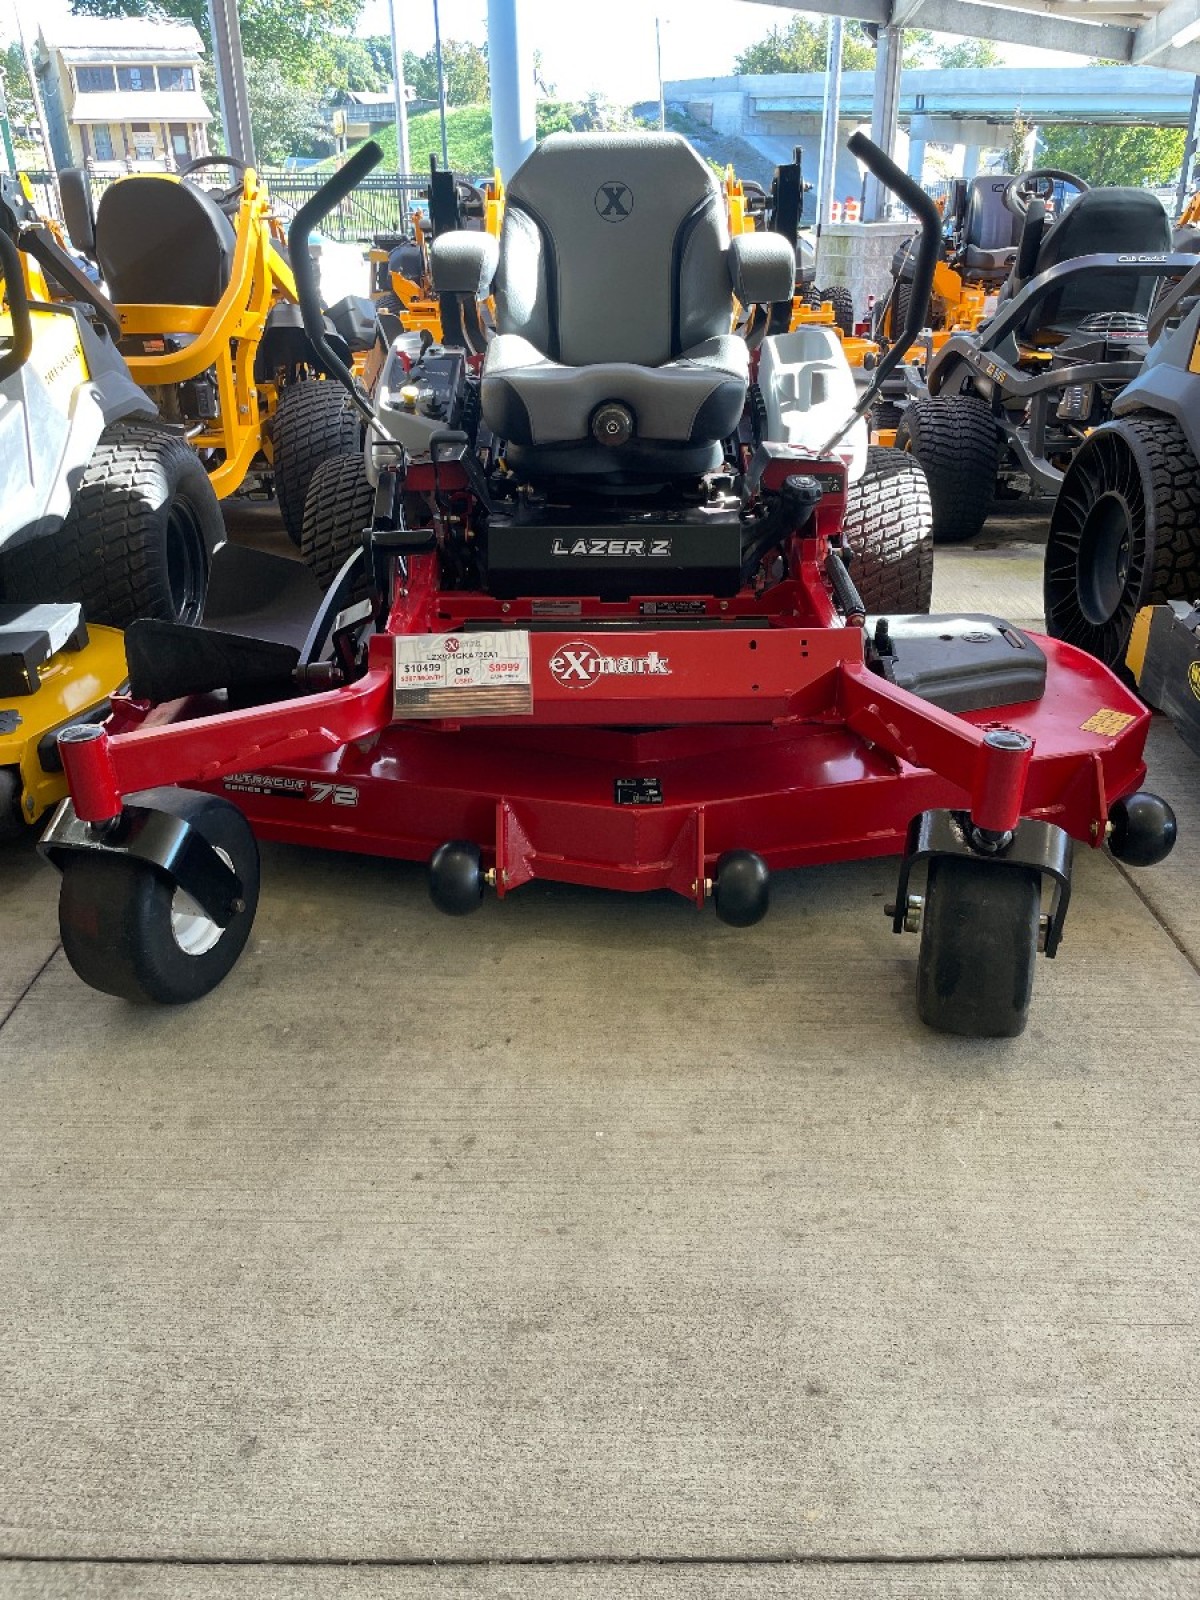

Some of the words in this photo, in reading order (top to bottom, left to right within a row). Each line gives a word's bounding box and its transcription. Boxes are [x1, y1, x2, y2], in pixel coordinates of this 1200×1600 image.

[598, 185, 630, 217] X
[551, 538, 646, 556] LAZER
[647, 538, 673, 557] Z
[403, 663, 441, 674] $10499
[455, 667, 470, 675] OR
[488, 662, 520, 673] $9999
[308, 781, 360, 808] 72
